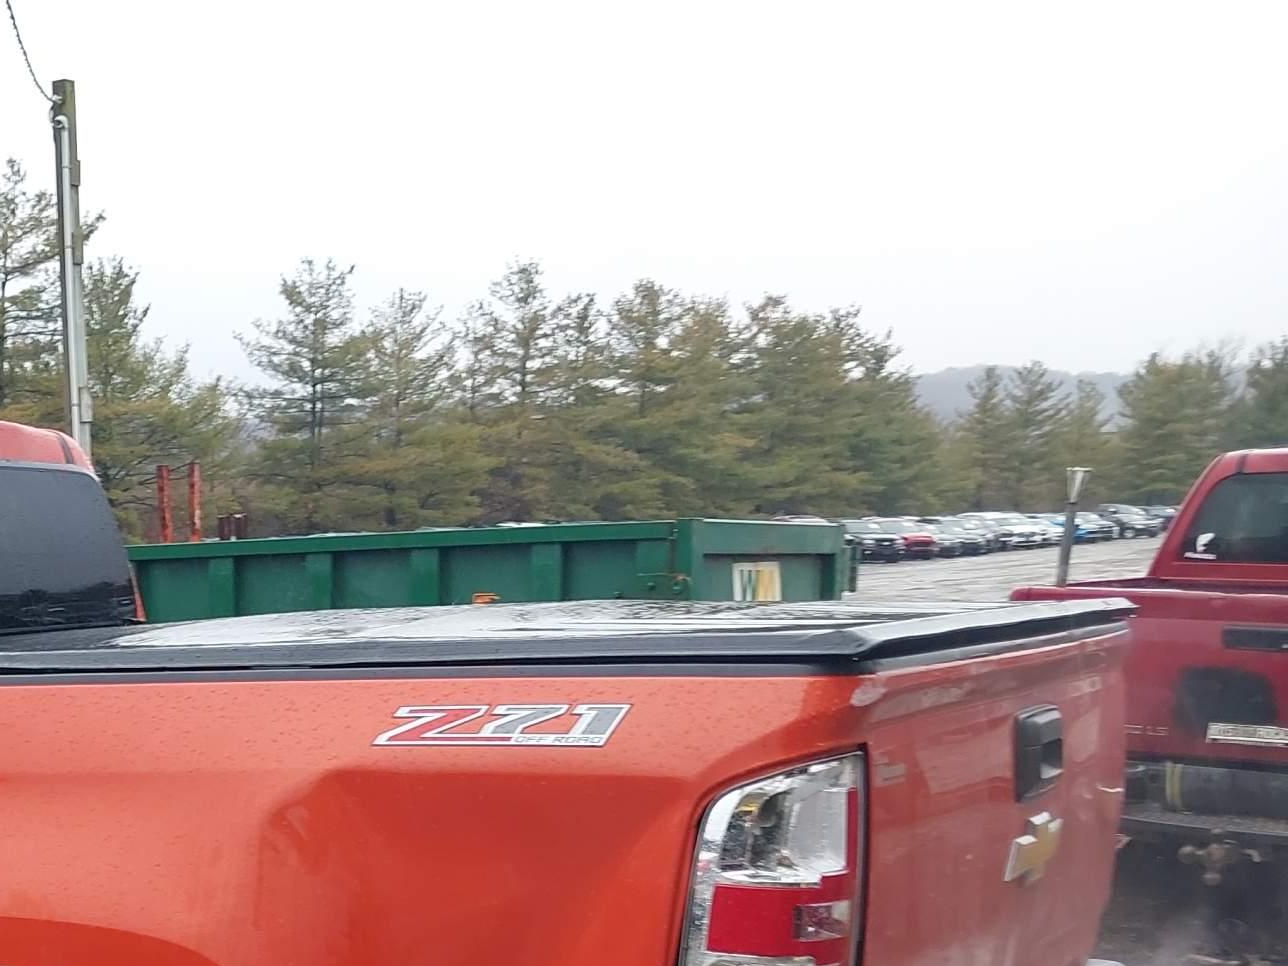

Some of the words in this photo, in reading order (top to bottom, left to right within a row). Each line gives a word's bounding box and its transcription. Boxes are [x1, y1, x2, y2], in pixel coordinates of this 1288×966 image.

[371, 703, 632, 748] Z71
[514, 735, 550, 744] OFF
[552, 735, 603, 744] ROAD
